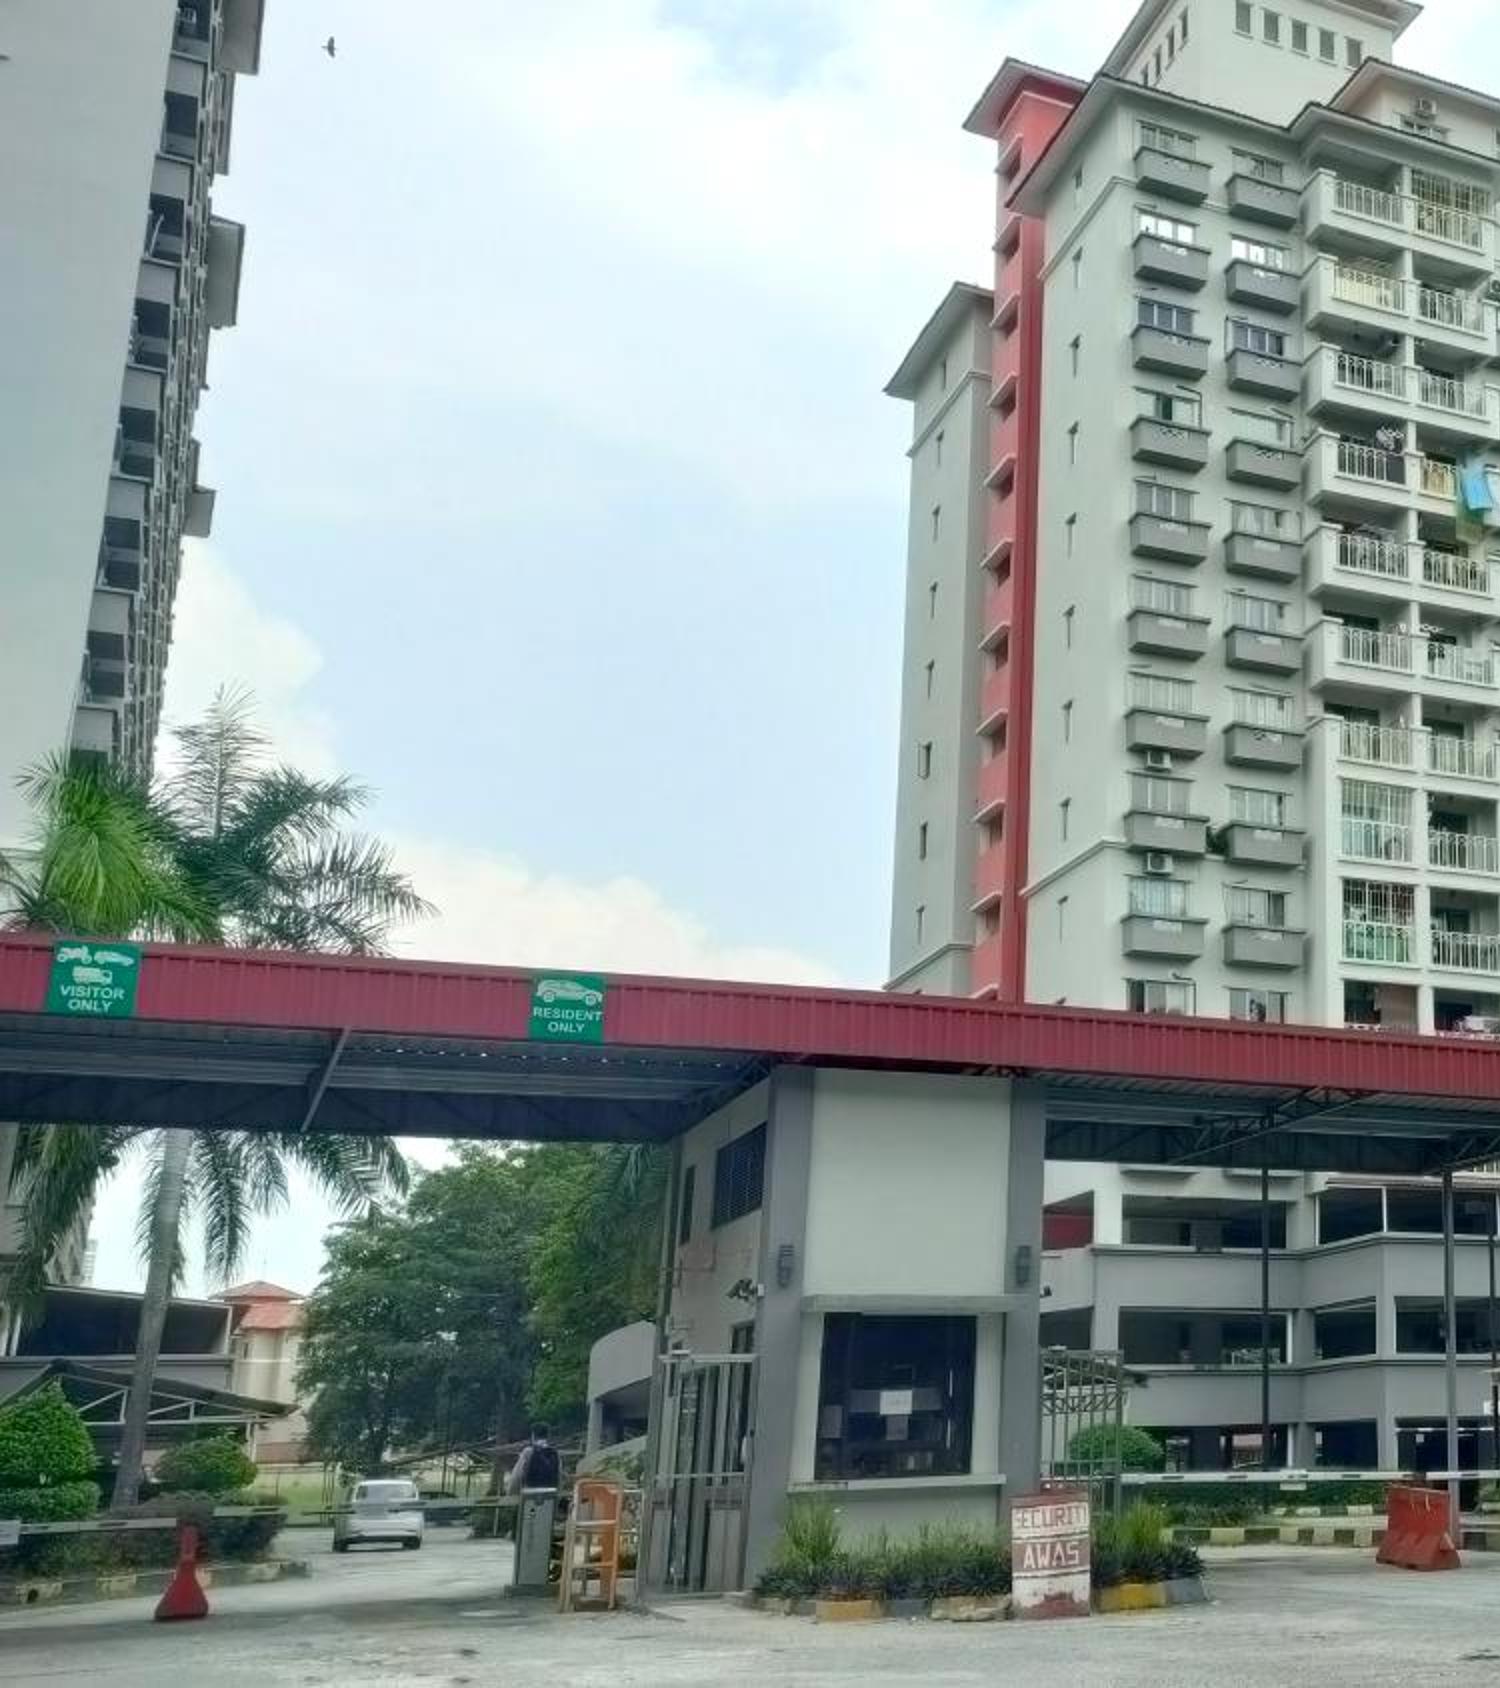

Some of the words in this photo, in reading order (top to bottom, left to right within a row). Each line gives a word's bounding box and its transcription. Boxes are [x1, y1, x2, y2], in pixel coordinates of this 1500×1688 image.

[60, 984, 125, 1000] VISITOR
[67, 998, 113, 1013] ONLY
[533, 1006, 604, 1022] RESIDENT
[547, 1021, 585, 1034] ONLY
[1023, 1541, 1079, 1569] AWAS
